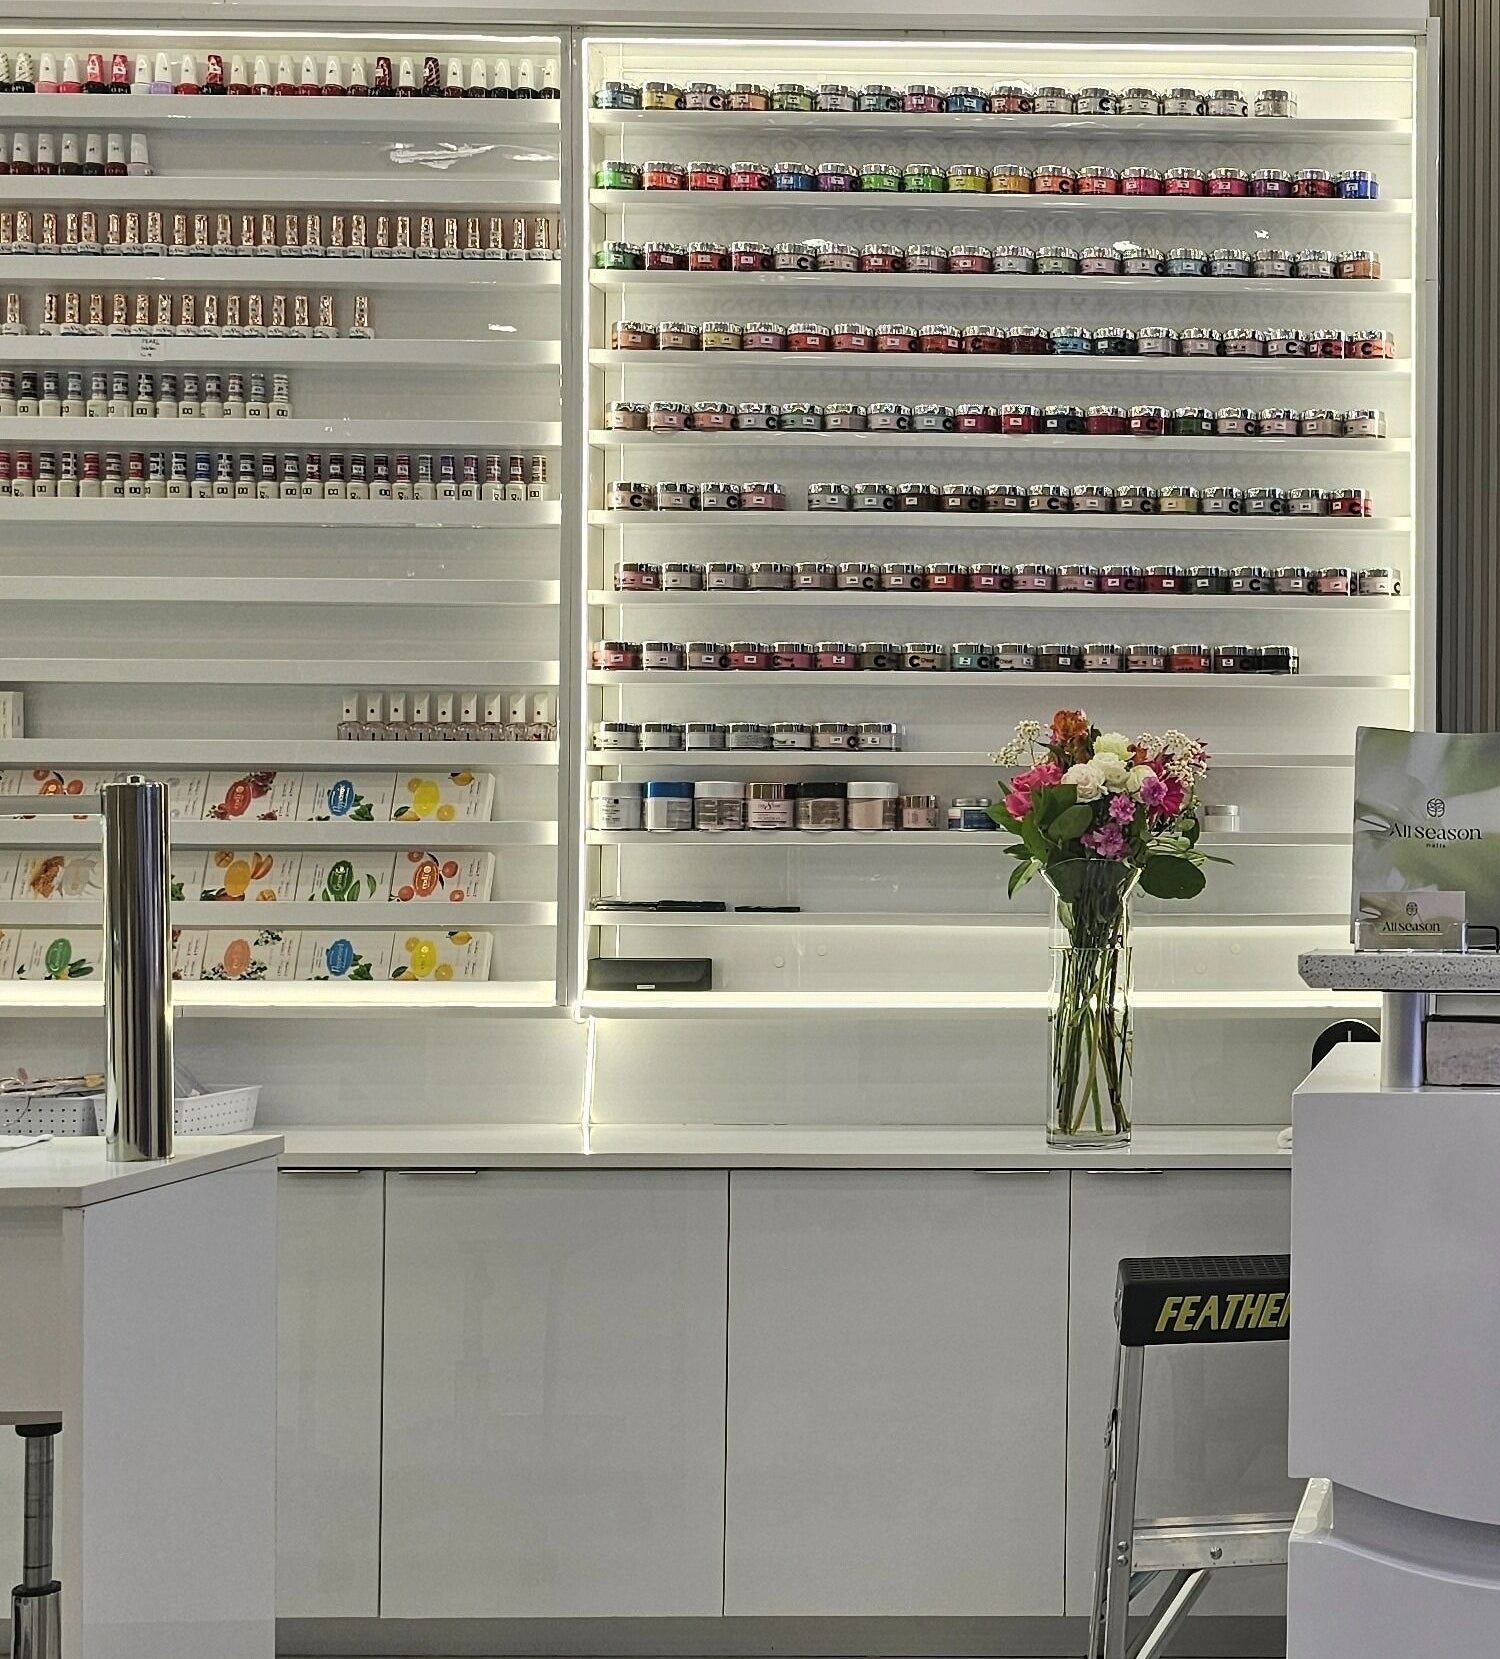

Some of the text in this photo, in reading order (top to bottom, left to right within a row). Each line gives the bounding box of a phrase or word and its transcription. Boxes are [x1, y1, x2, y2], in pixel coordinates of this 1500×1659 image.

[709, 95, 722, 108] C
[1099, 97, 1110, 110] C
[1059, 180, 1070, 192] C
[796, 257, 808, 270] C
[1286, 341, 1298, 353] C
[1361, 342, 1373, 355] C
[766, 416, 777, 429] C
[897, 416, 908, 429] C
[943, 417, 953, 430] C
[1244, 421, 1255, 433] C
[629, 494, 642, 507] C
[727, 495, 739, 508] C
[883, 497, 895, 509] C
[1047, 497, 1059, 509] C
[1141, 499, 1151, 511] C
[1229, 500, 1240, 512] C
[1271, 500, 1281, 512] C
[1350, 502, 1361, 514] C
[862, 576, 873, 588] C
[911, 576, 921, 588] C
[1250, 578, 1261, 590] C
[875, 654, 886, 667] C
[978, 656, 990, 668] C
